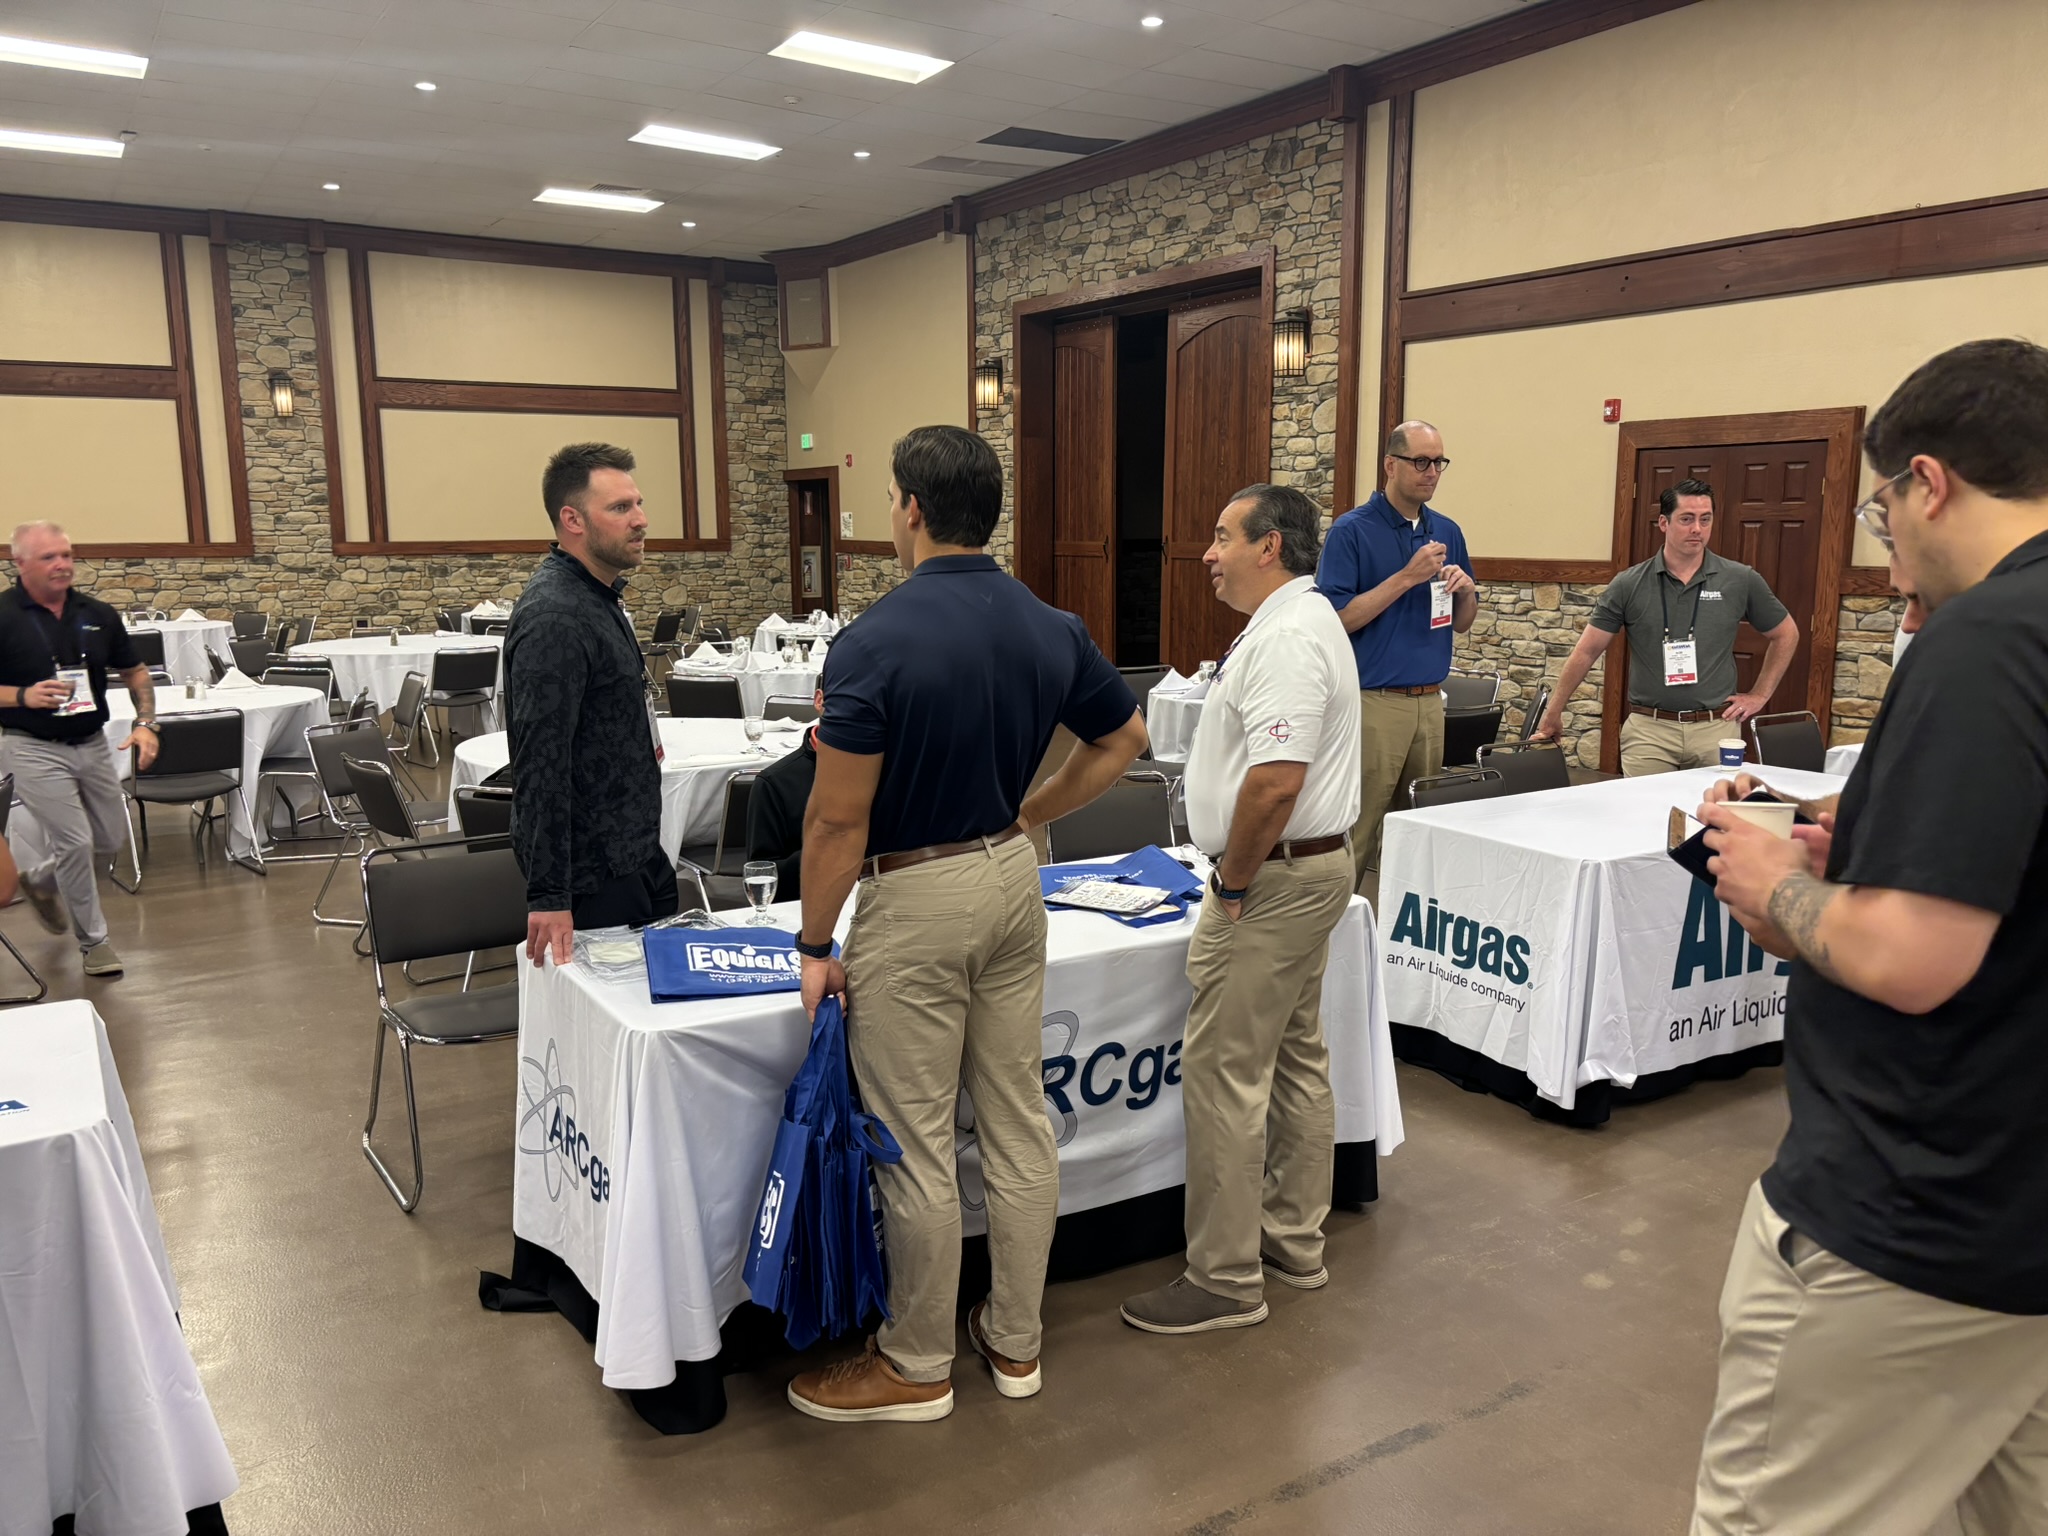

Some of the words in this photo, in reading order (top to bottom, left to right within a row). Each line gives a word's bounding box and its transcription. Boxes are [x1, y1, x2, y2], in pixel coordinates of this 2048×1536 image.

[1390, 891, 1530, 985] Airgas
[1386, 953, 1404, 966] an
[1407, 956, 1425, 971] Air
[1429, 961, 1468, 988] Liquide
[1471, 981, 1526, 1013] company
[1669, 1017, 1693, 1042] an
[1698, 1003, 1726, 1035] Air
[1041, 1038, 1183, 1115] RCga
[549, 1105, 610, 1203] ARCga
